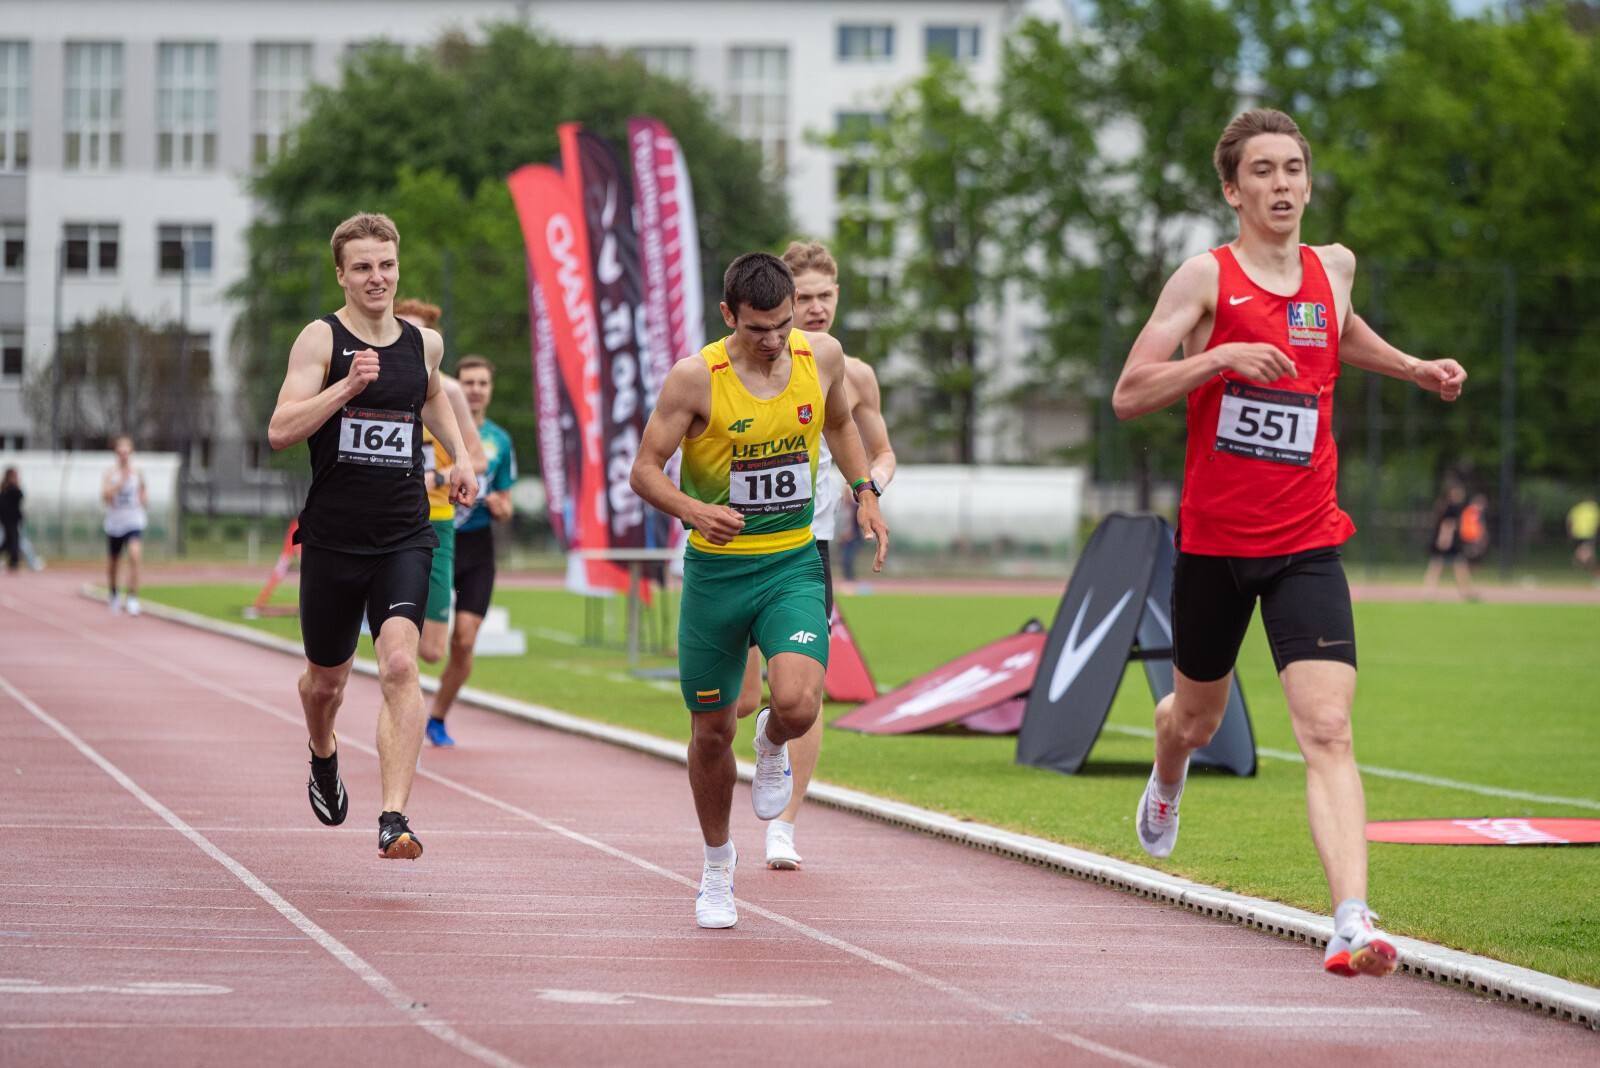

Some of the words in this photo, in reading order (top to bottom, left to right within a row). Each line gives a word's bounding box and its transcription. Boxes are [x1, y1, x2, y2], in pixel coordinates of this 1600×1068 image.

[350, 423, 405, 452] 164
[728, 418, 754, 433] 4F
[1235, 406, 1299, 444] 551
[733, 435, 807, 457] LIETUVA
[745, 470, 796, 501] 118
[789, 630, 818, 644] 4F
